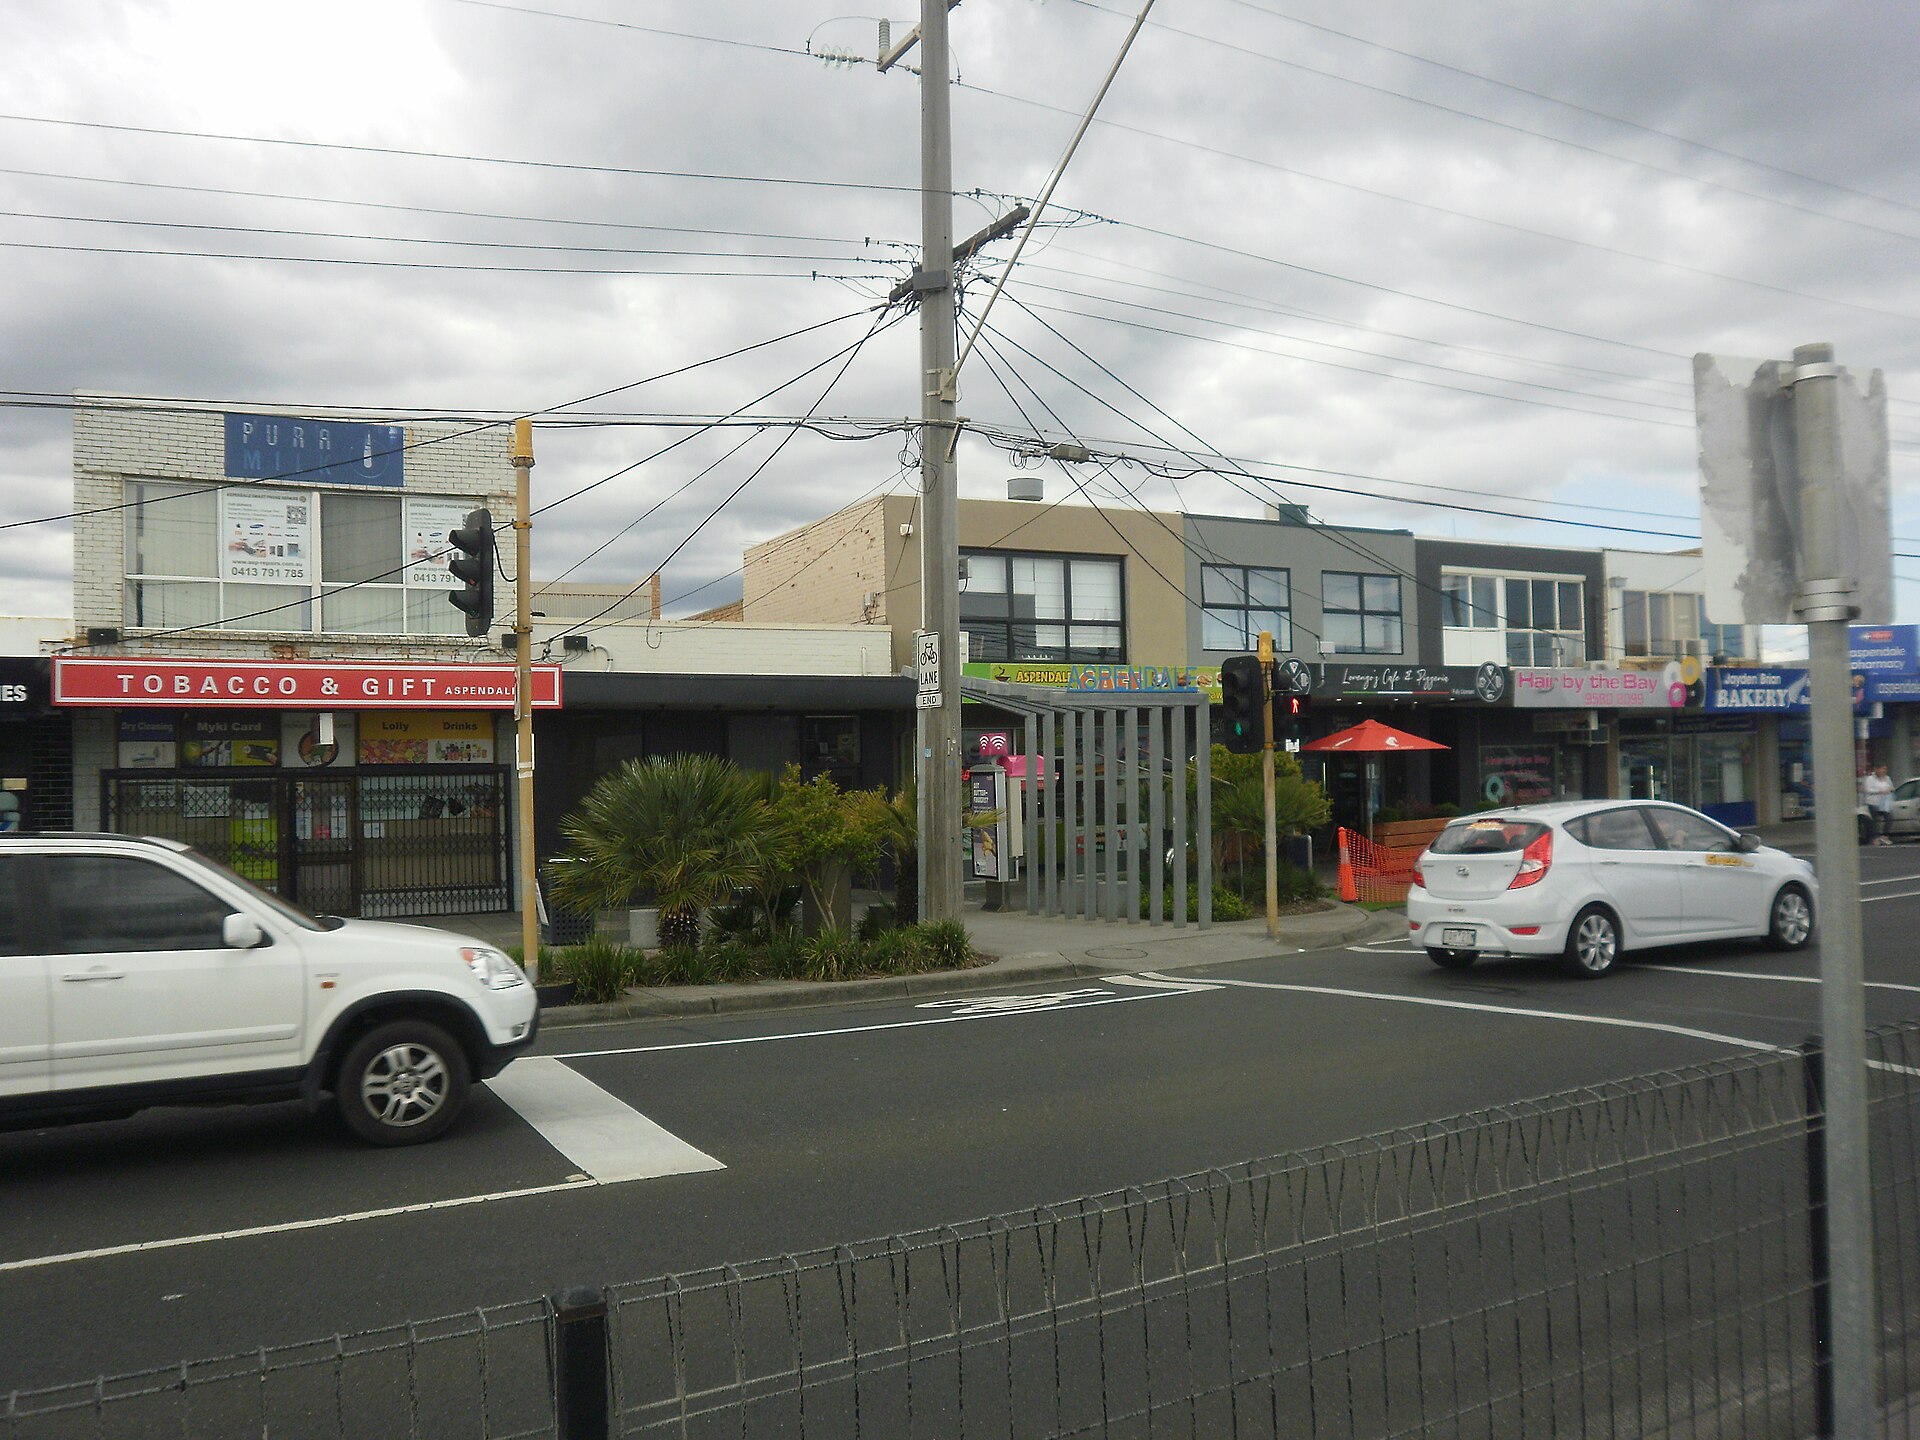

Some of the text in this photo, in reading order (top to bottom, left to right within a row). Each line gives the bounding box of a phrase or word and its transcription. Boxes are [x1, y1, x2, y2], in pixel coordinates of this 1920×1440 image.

[242, 422, 331, 450] PURA
[231, 566, 303, 578] 0413 791 785
[413, 573, 437, 582] 0413
[117, 673, 297, 694] TOBACCO
[320, 677, 340, 695] &
[362, 677, 437, 696] GIFT
[920, 670, 938, 685] LANE
[1067, 664, 1198, 690] ASPENDALE
[1518, 672, 1658, 693] Hair by the Bay
[922, 695, 937, 705] END
[1717, 688, 1789, 708] BAKERY
[197, 722, 262, 733] Myki Card
[382, 721, 477, 732] Lolly Drinks
